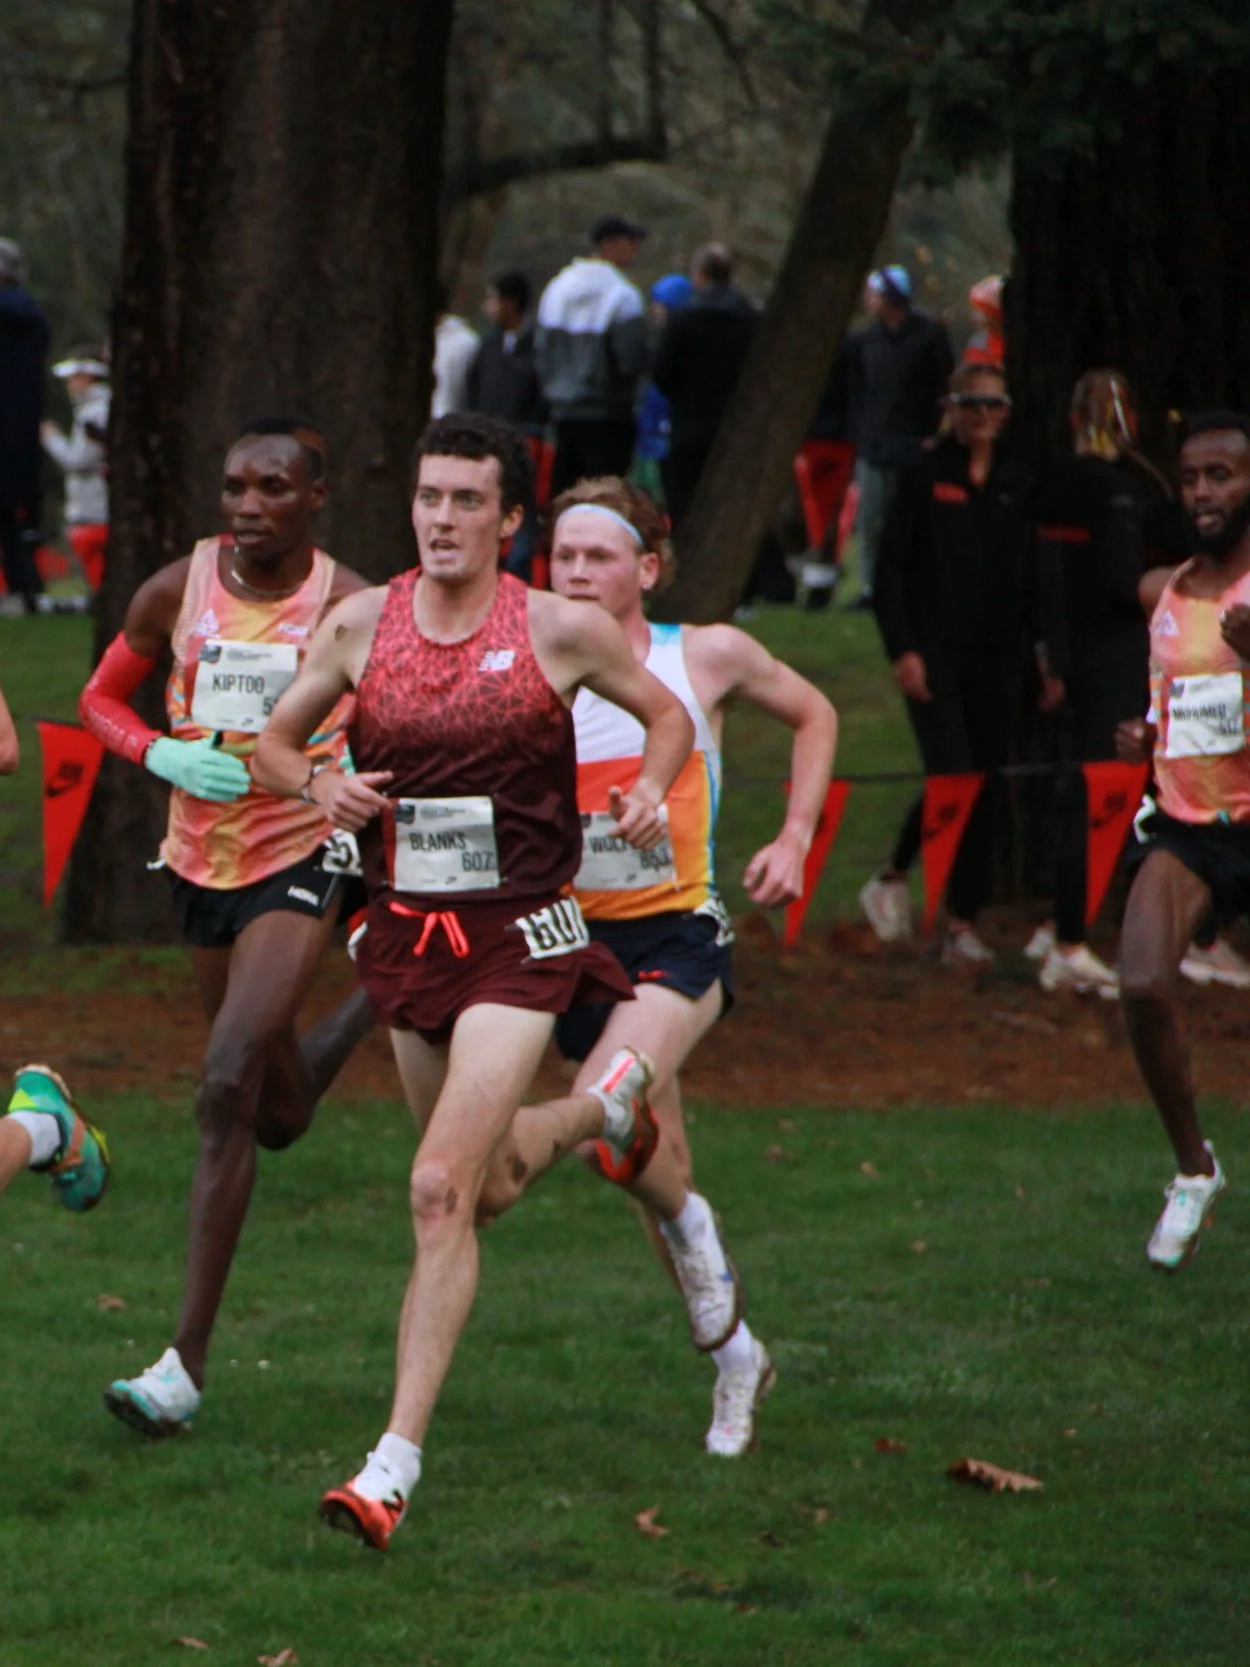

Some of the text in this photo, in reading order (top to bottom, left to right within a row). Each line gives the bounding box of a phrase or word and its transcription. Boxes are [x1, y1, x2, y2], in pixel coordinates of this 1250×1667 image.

[212, 674, 266, 694] KIPTOO
[409, 831, 467, 851] BLANKS
[461, 851, 494, 872] 607
